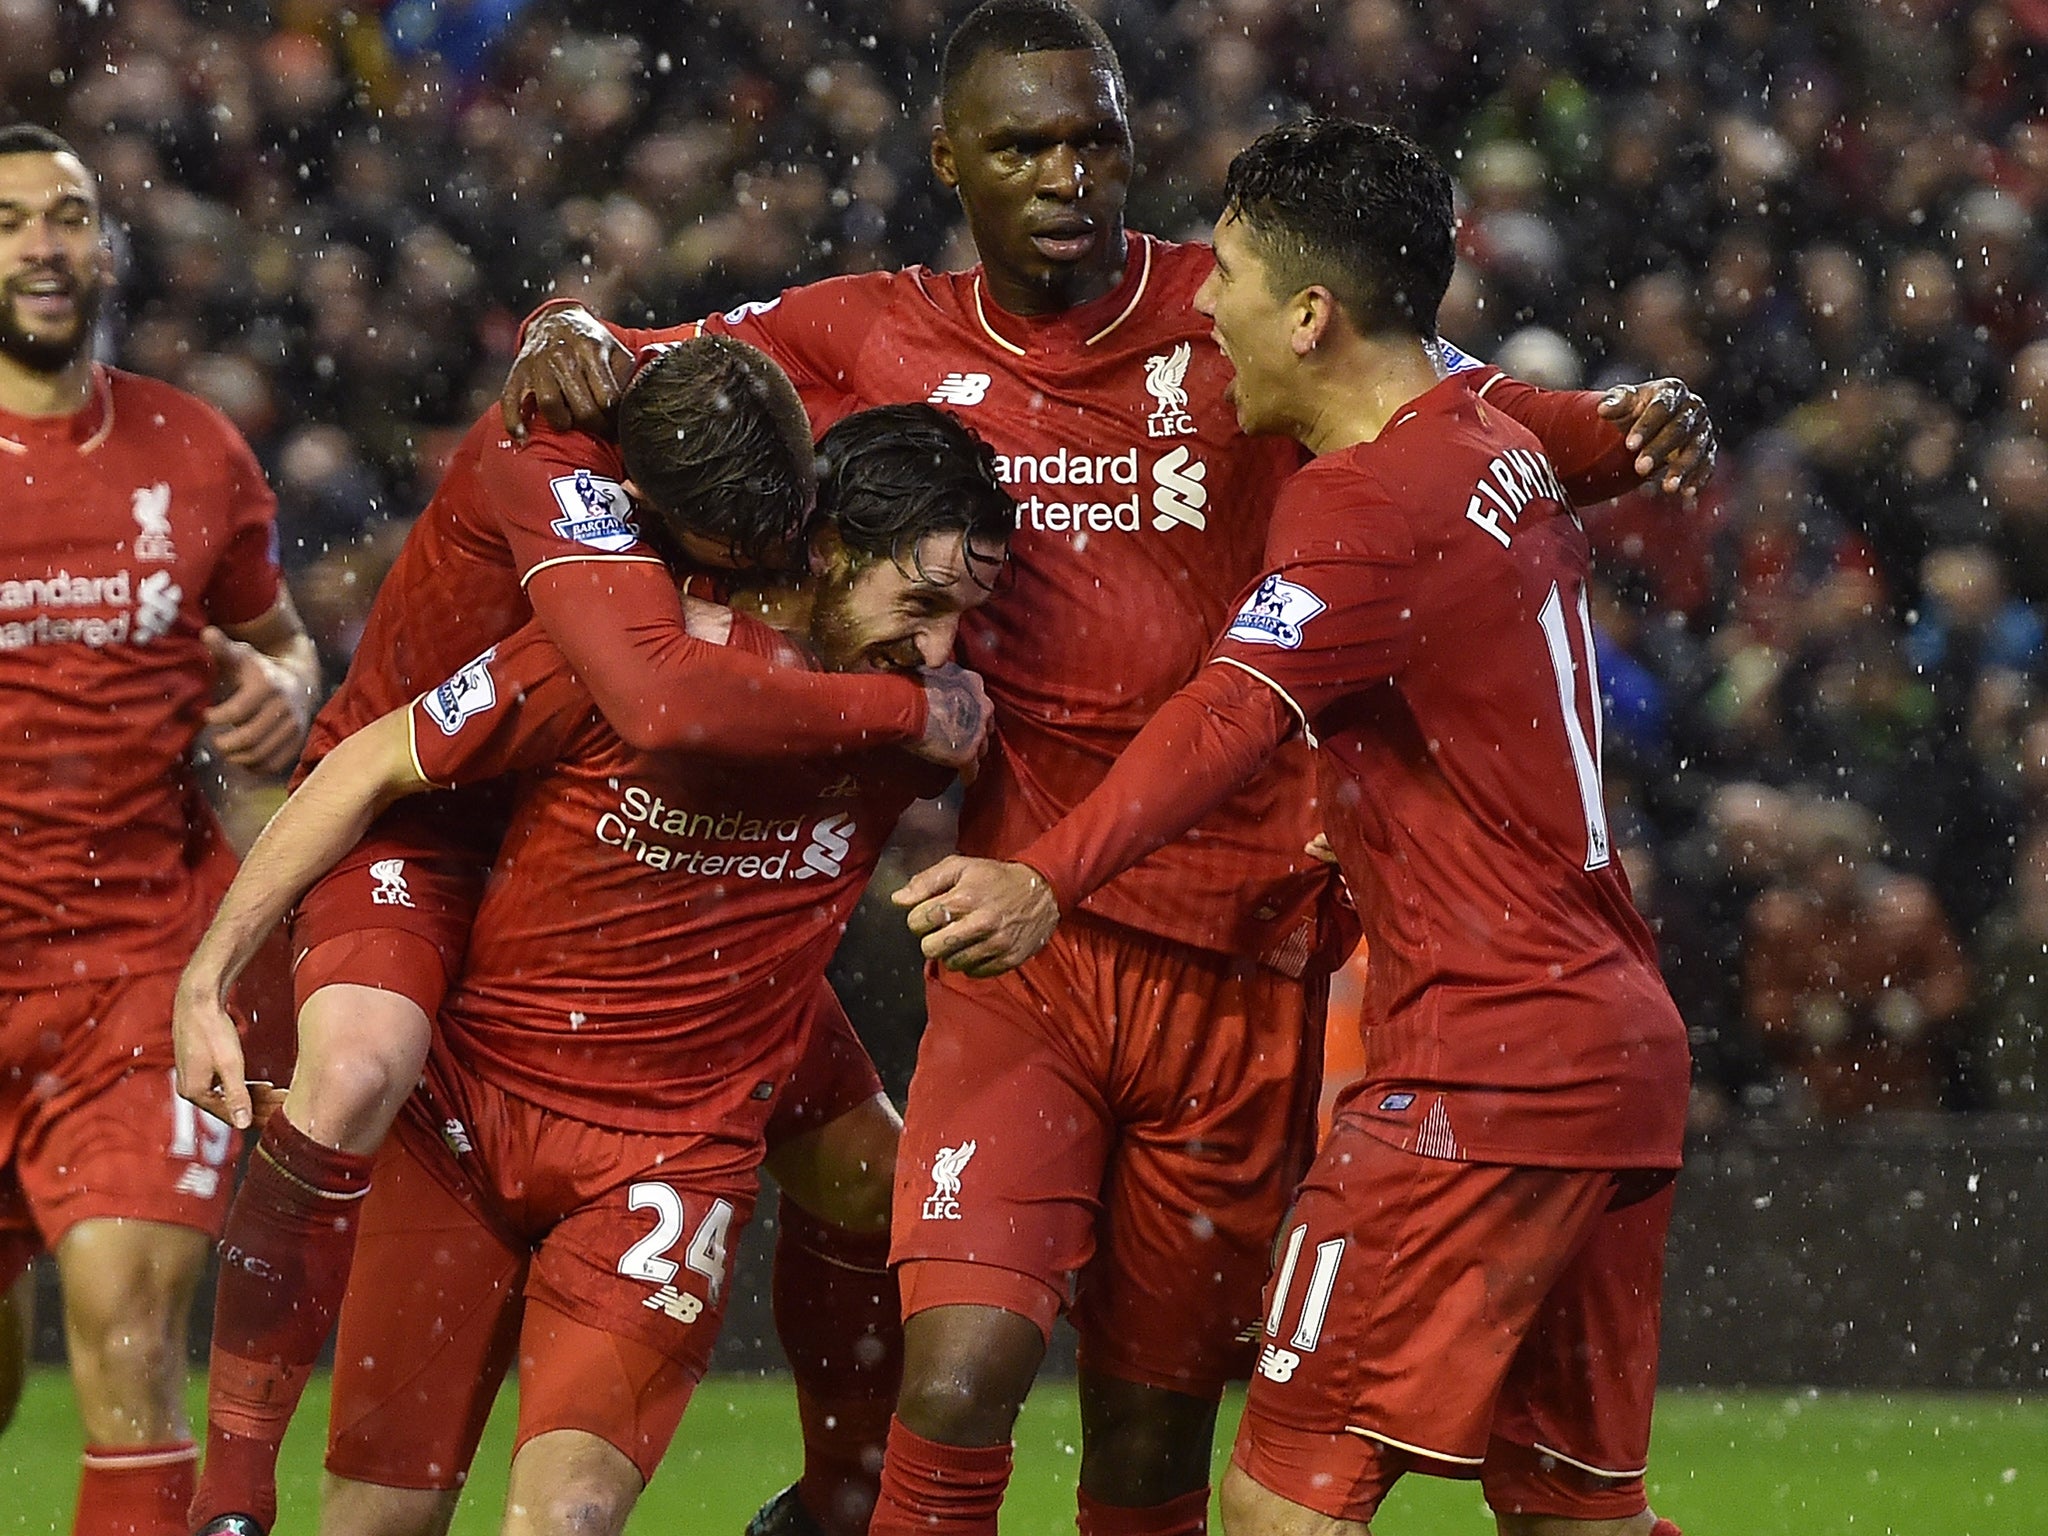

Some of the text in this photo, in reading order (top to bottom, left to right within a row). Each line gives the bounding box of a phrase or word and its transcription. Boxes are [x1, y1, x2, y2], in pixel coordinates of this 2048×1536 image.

[1147, 415, 1198, 437] L.F.C.
[993, 447, 1137, 485] andard
[573, 518, 620, 534] BARCLAY
[1015, 493, 1141, 532] rtered
[0, 569, 131, 610] andard
[0, 610, 130, 651] artered
[1537, 579, 1609, 871] 11
[620, 786, 805, 842] Standard
[595, 812, 791, 880] Chartered
[922, 1201, 962, 1220] L.F.C.
[617, 1181, 734, 1308] 24
[1266, 1223, 1345, 1352] 11
